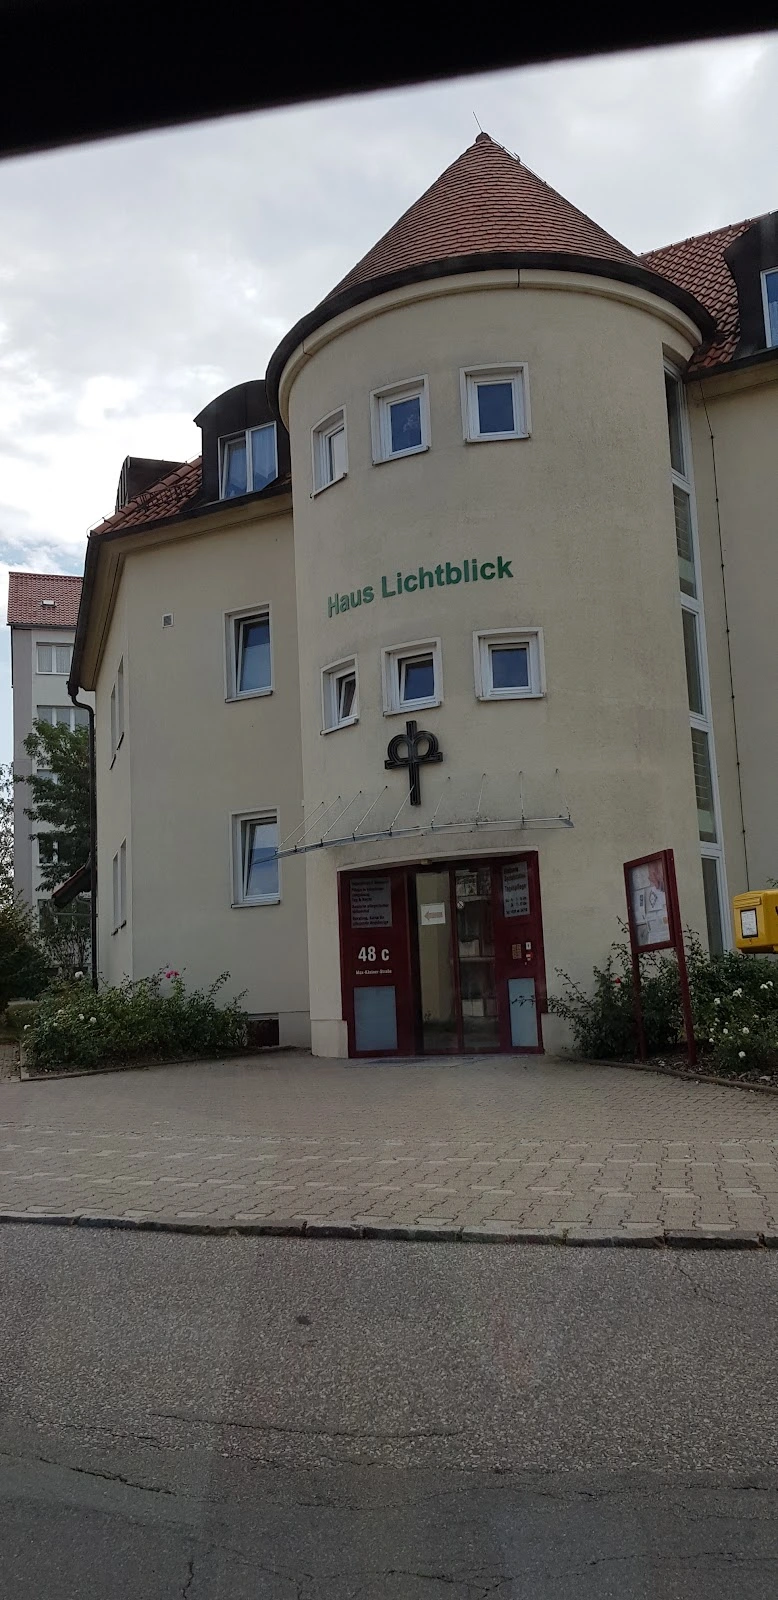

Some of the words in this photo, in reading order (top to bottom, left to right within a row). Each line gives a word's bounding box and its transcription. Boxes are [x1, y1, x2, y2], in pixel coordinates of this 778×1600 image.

[327, 585, 375, 618] Haus
[381, 556, 514, 598] Lichtblick
[358, 945, 377, 962] 48
[381, 948, 390, 961] c
